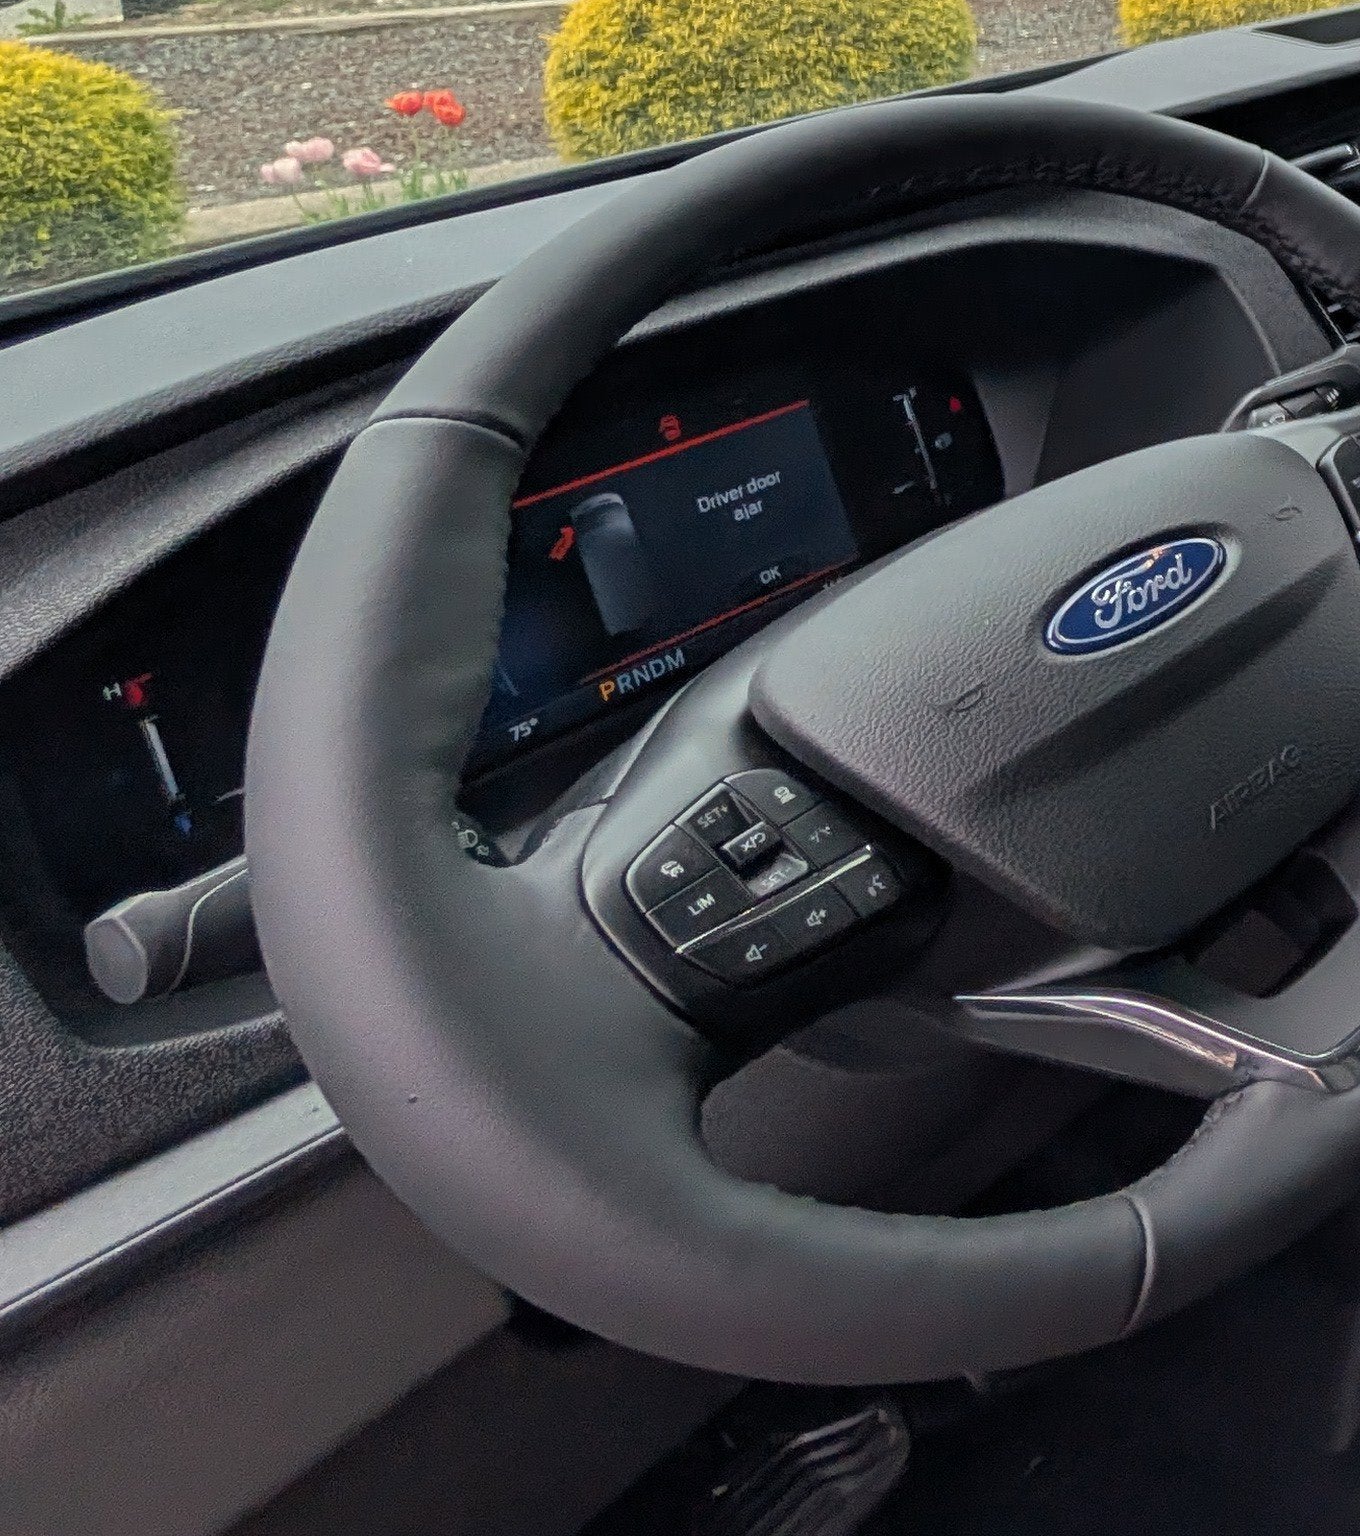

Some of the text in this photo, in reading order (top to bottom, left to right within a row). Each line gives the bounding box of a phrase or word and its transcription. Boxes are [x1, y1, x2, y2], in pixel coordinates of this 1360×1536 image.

[696, 471, 782, 514] Driver door
[734, 498, 763, 522] ajar
[759, 565, 782, 584] OK
[1091, 553, 1192, 629] Ford
[688, 893, 716, 916] LIM
